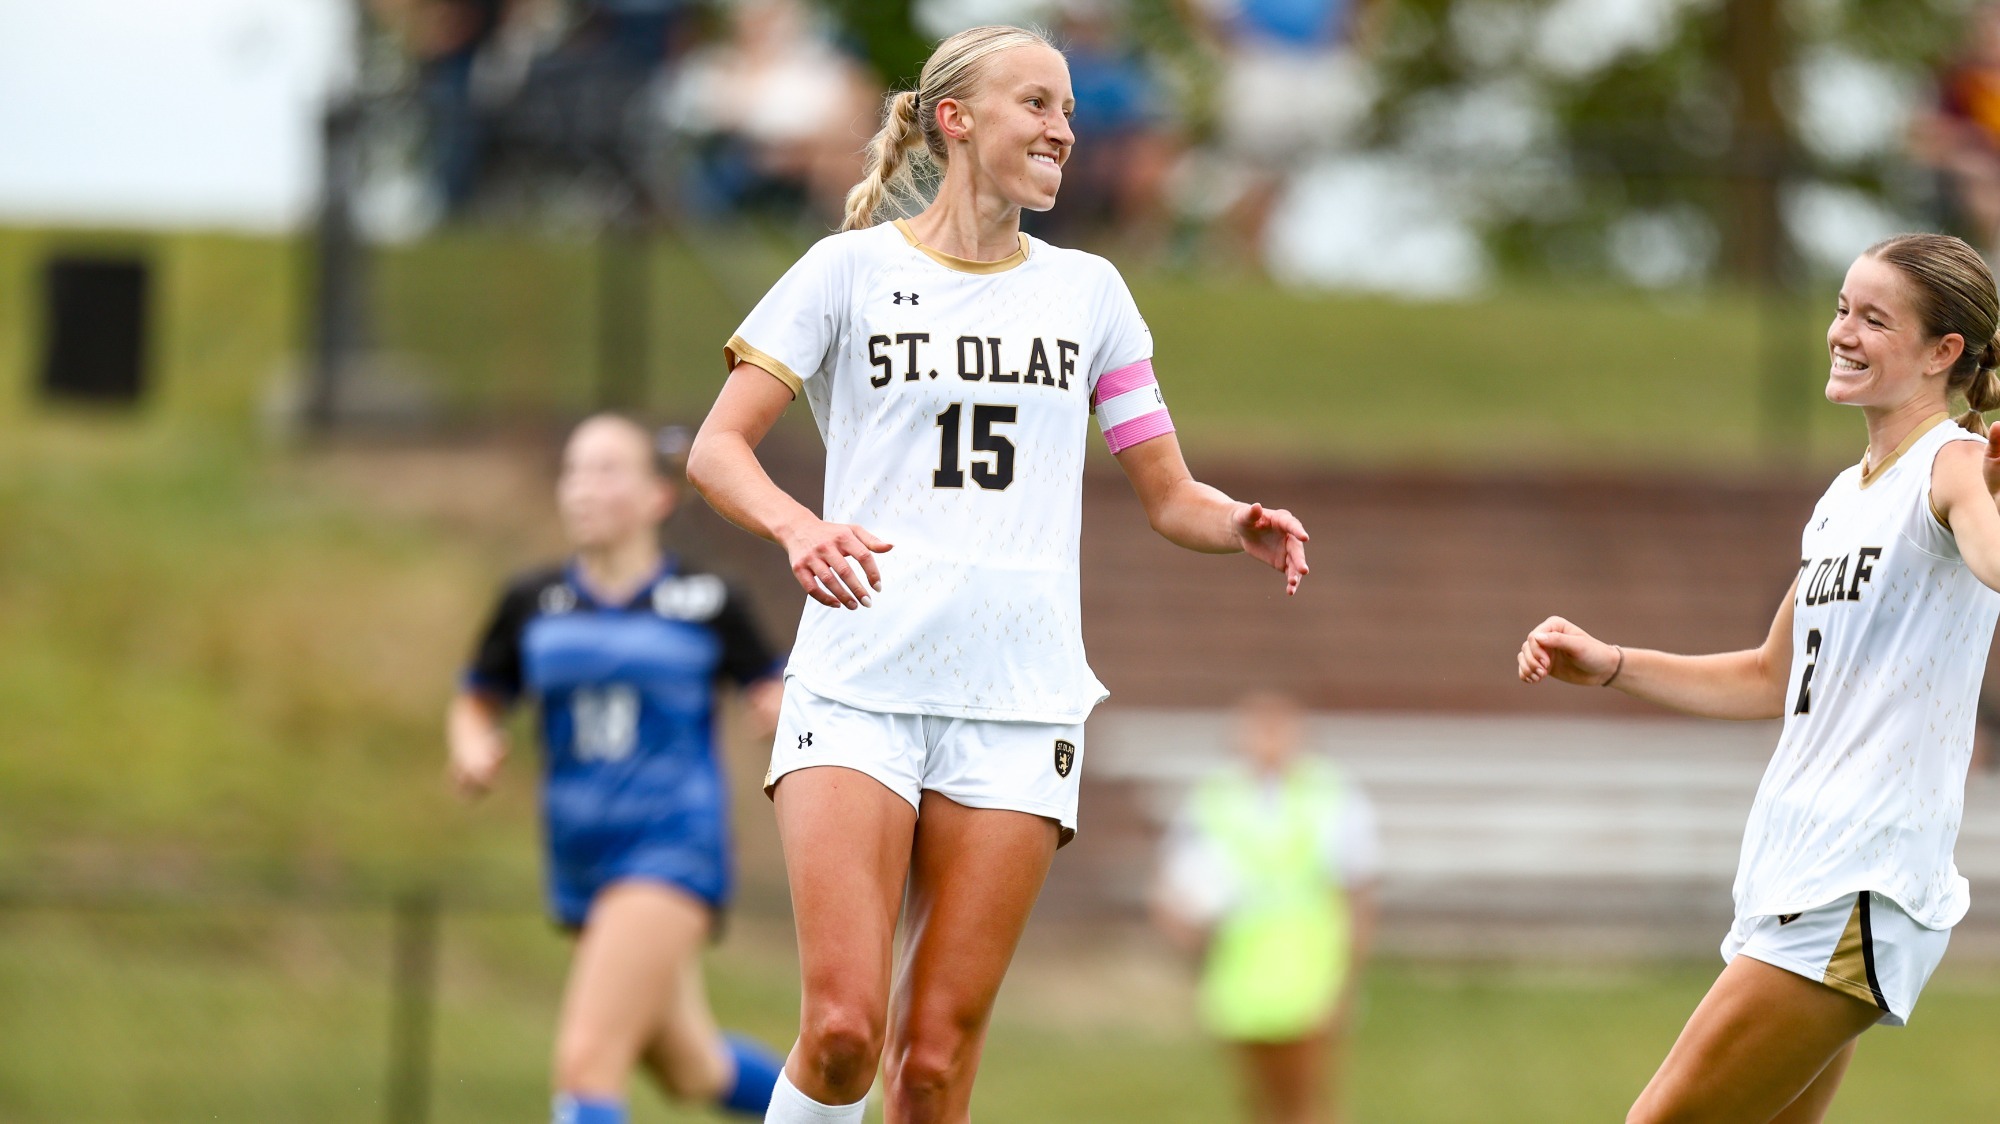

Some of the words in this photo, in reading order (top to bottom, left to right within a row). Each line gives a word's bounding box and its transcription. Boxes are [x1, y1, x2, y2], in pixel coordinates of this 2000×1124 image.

[868, 332, 939, 389] ST.
[956, 335, 1080, 391] OLAF
[932, 401, 1018, 491] 15
[1805, 546, 1883, 607] OLAF
[1793, 627, 1823, 716] 2
